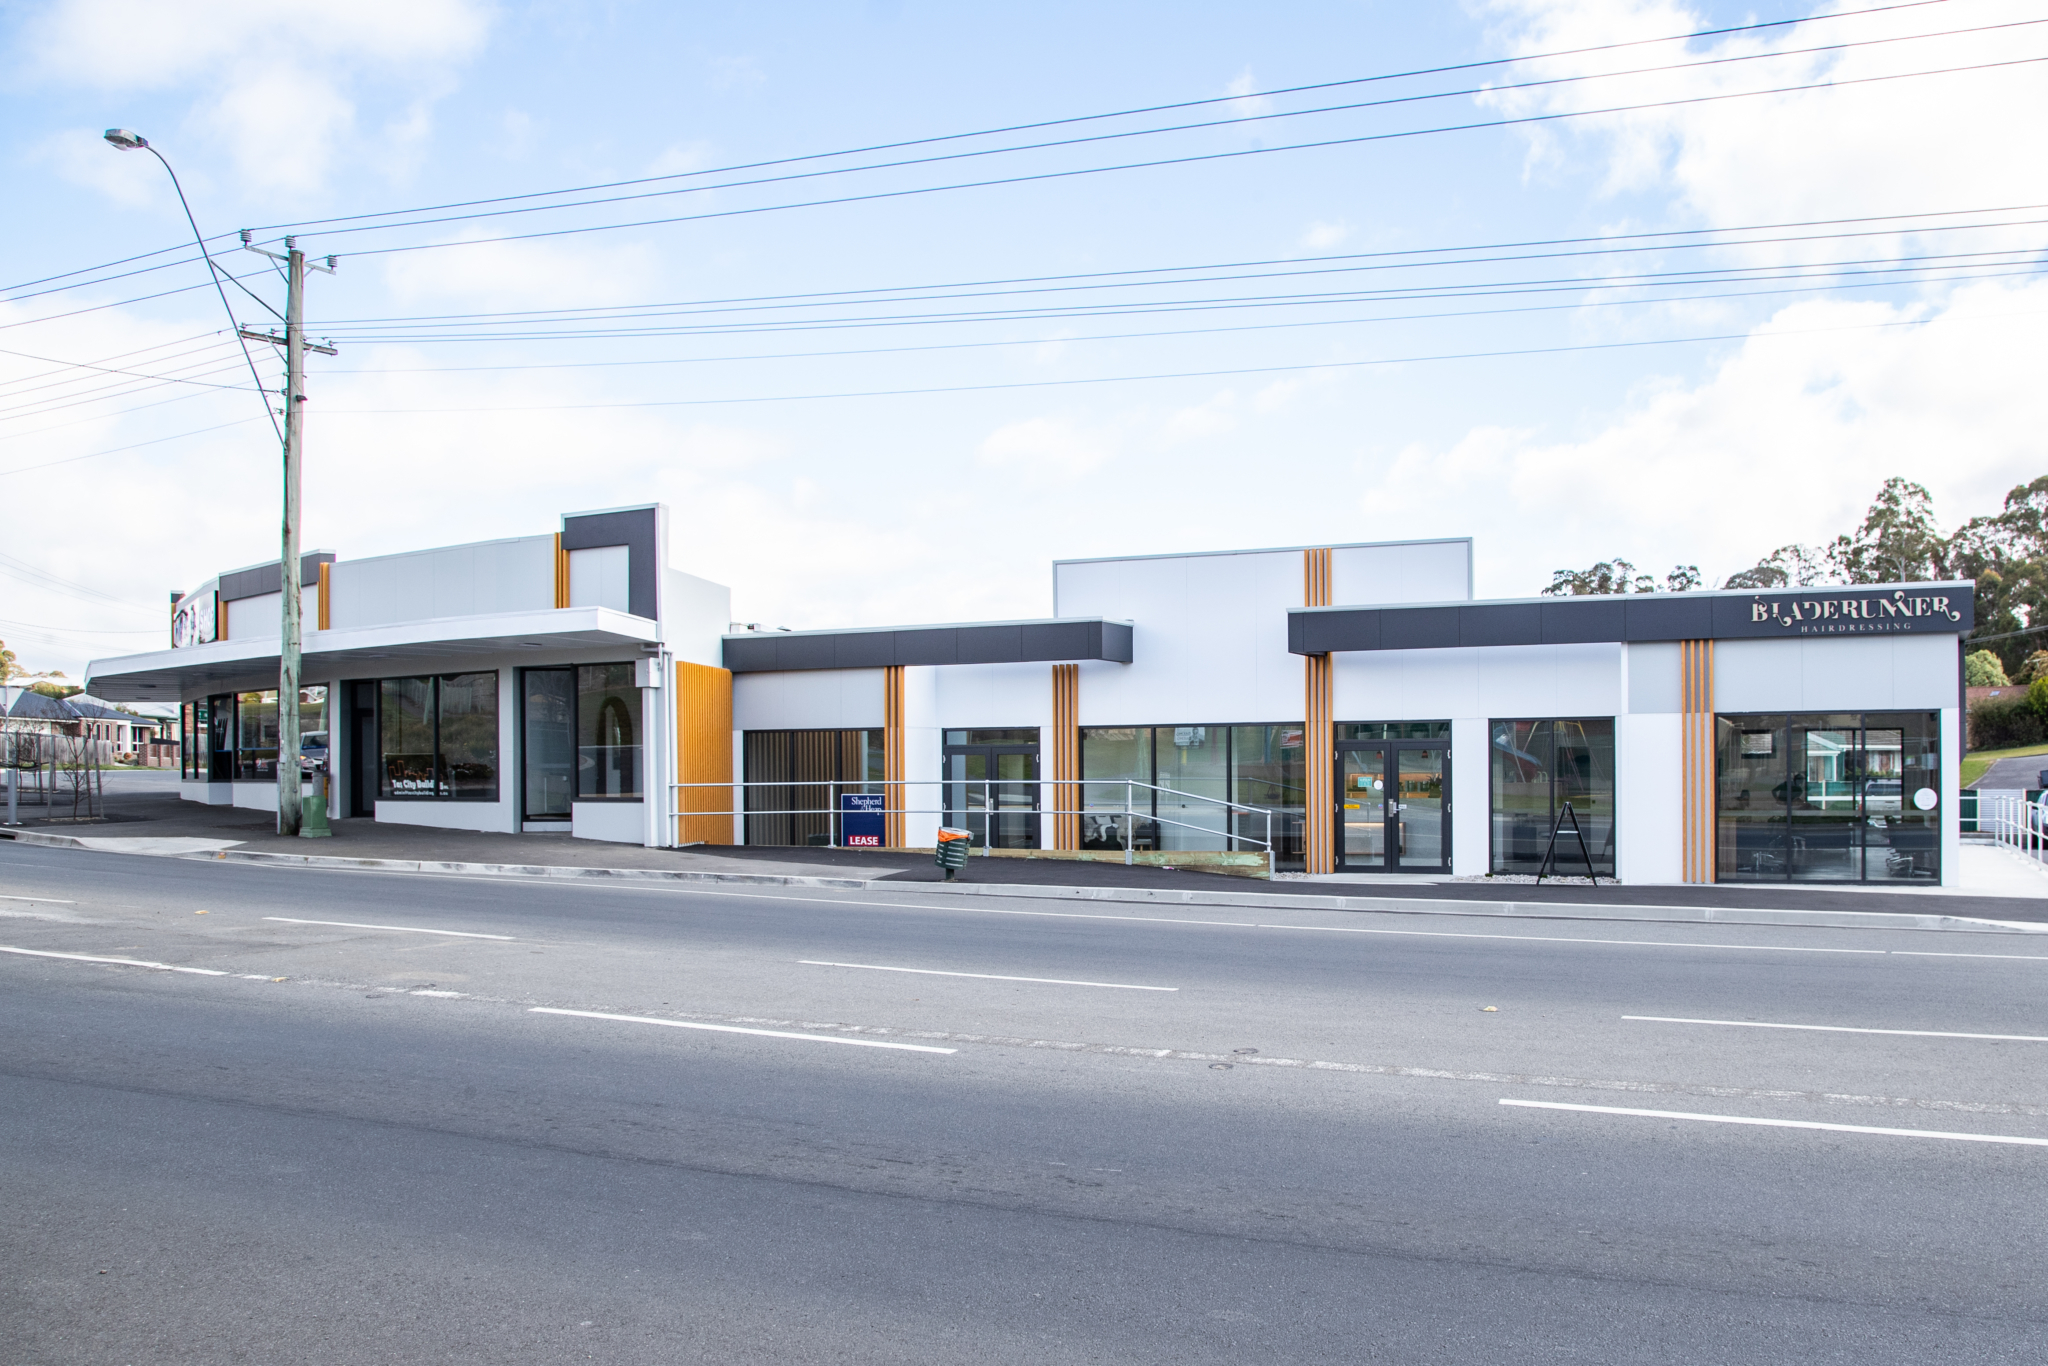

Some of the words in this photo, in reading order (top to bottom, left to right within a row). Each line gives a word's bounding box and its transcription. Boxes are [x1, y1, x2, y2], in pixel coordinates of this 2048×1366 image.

[1751, 590, 1961, 627] BLADERUNNER
[1801, 622, 1912, 633] HAIRDRESSING
[403, 779, 416, 790] City
[851, 796, 882, 808] Shepherd
[849, 836, 879, 845] LEASE
